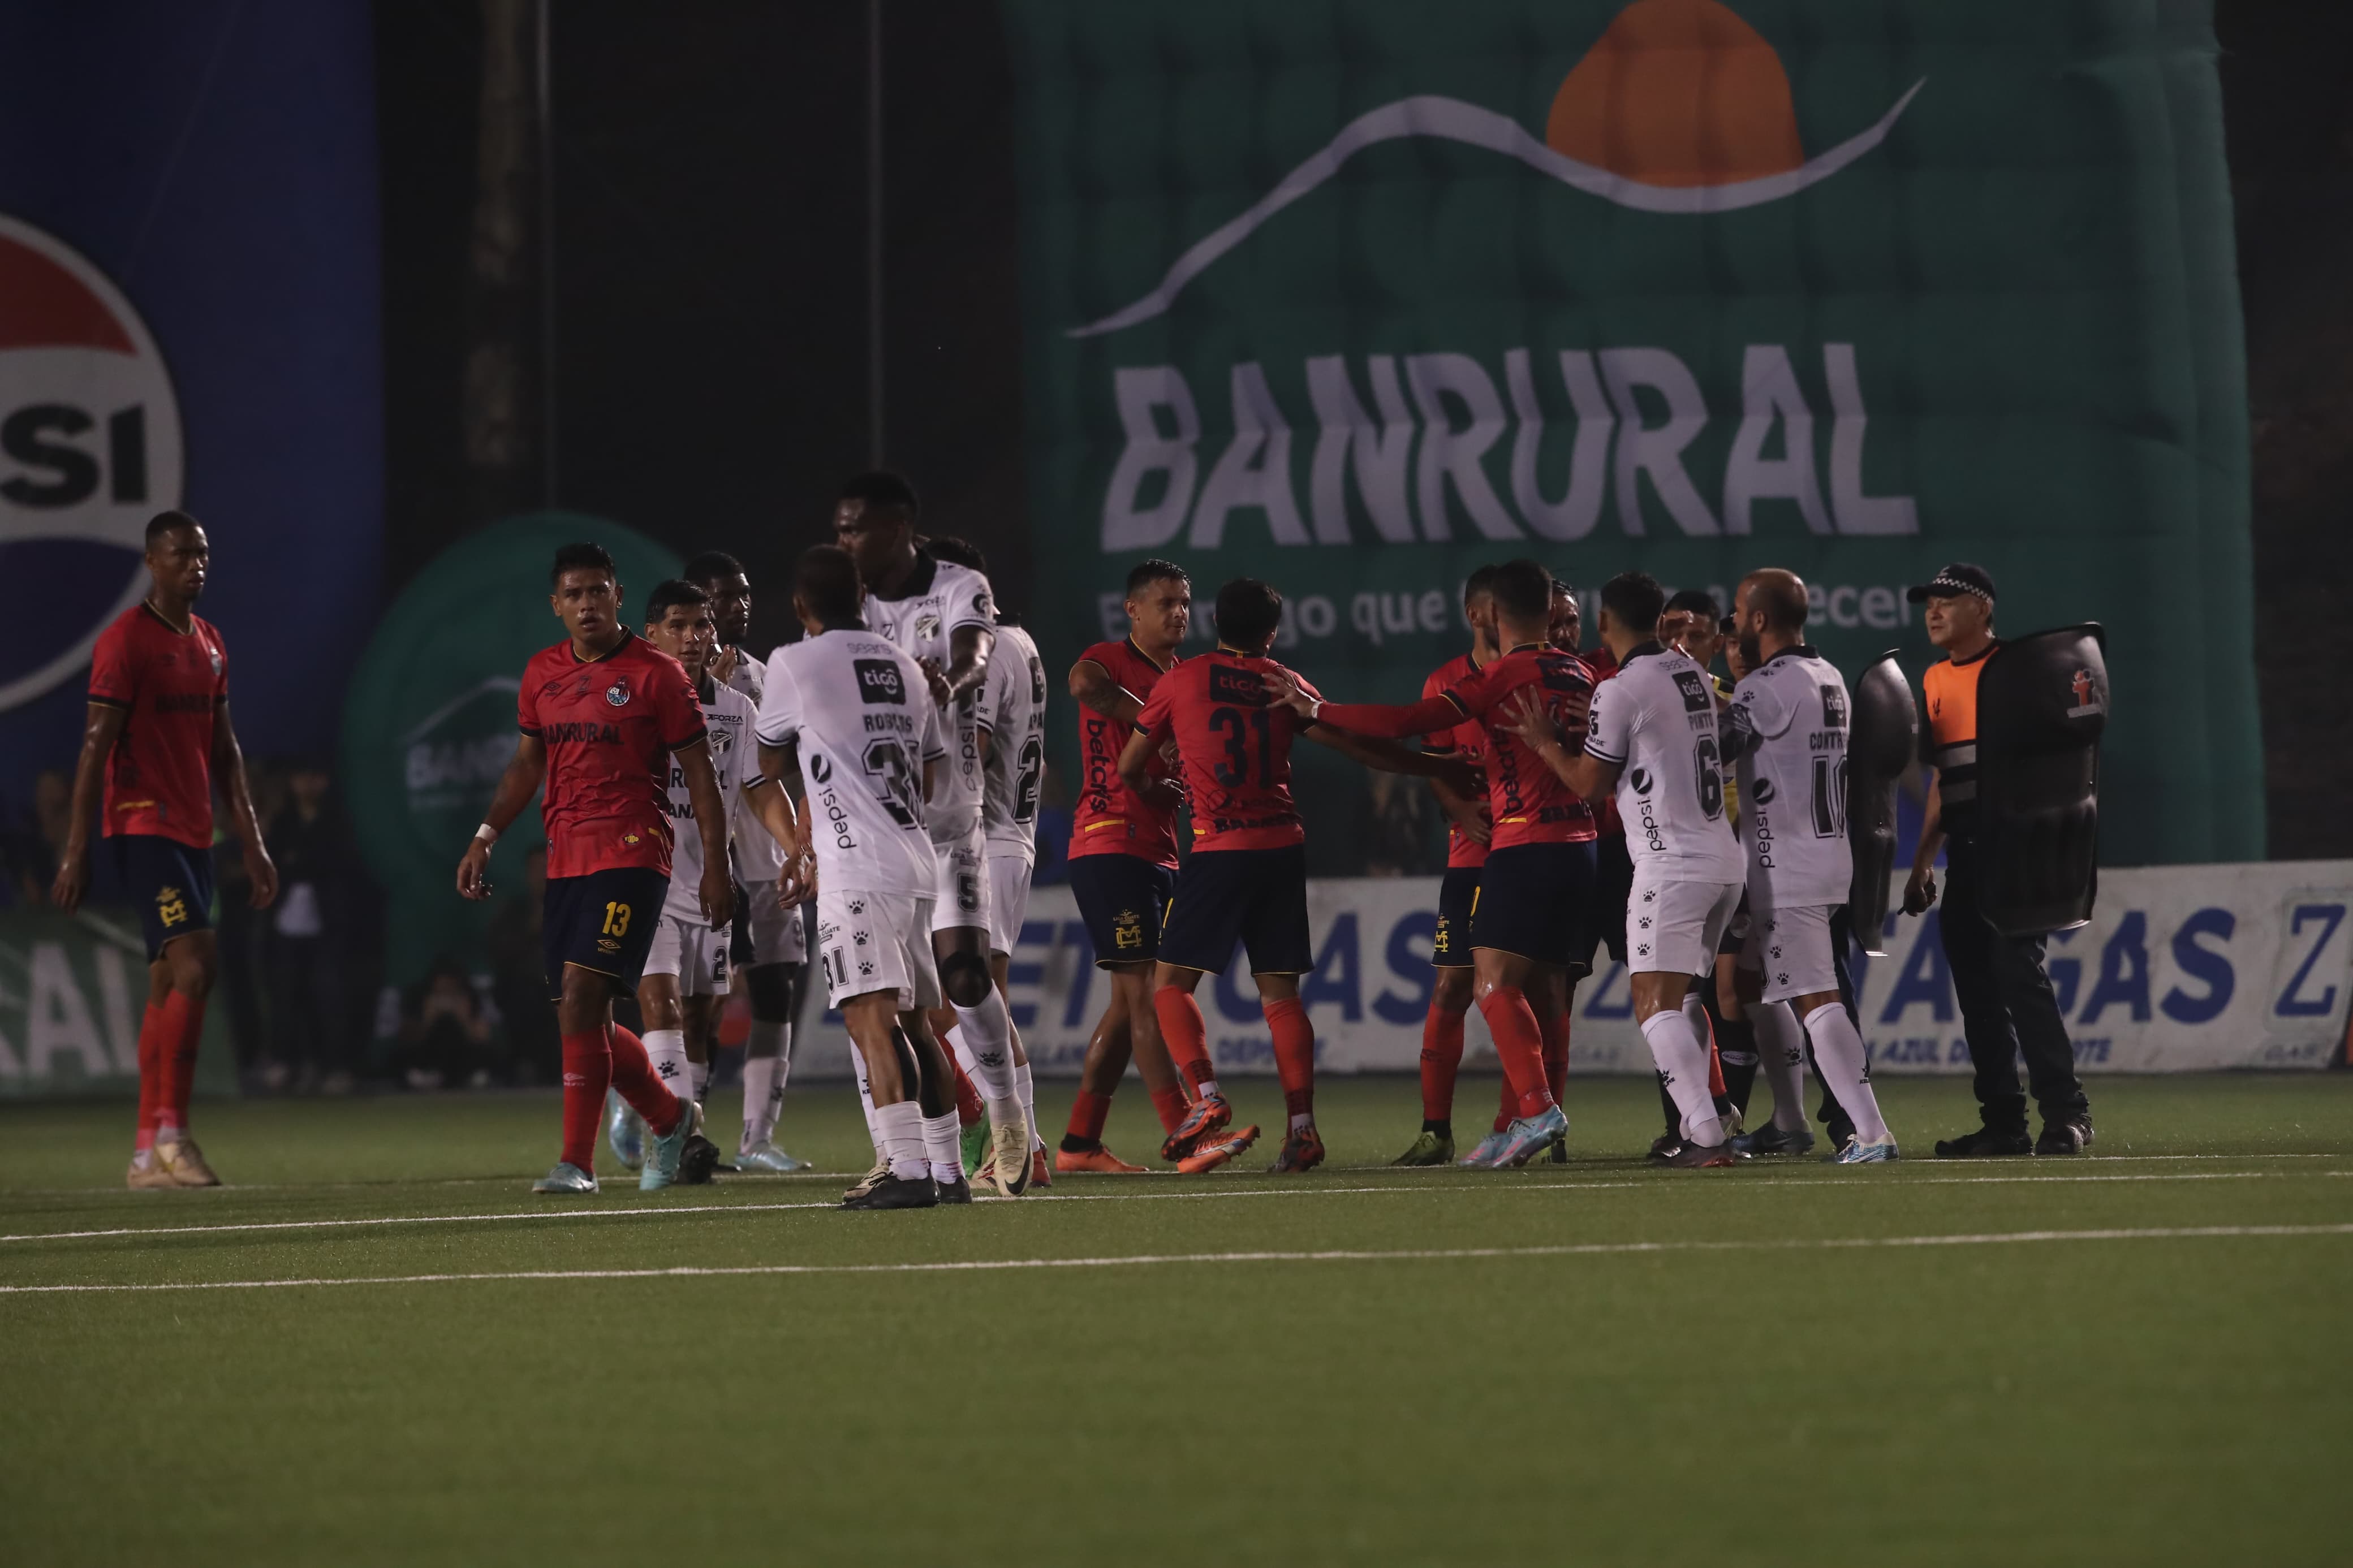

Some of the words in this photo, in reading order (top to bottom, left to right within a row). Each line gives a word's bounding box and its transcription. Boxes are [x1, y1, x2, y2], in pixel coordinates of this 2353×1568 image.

[1101, 342, 1920, 553] BANRURAL
[1351, 588, 1449, 645] que
[1208, 707, 1273, 789] 31
[1688, 712, 1714, 732] PINTO
[1087, 718, 1111, 815] betcris
[1693, 733, 1725, 822] 6
[819, 790, 857, 849] pepsi
[1636, 797, 1666, 852] pepsi
[1755, 808, 1775, 869] pepsi
[602, 901, 632, 938] 13
[957, 872, 980, 913] 5
[2274, 903, 2347, 1017] Z
